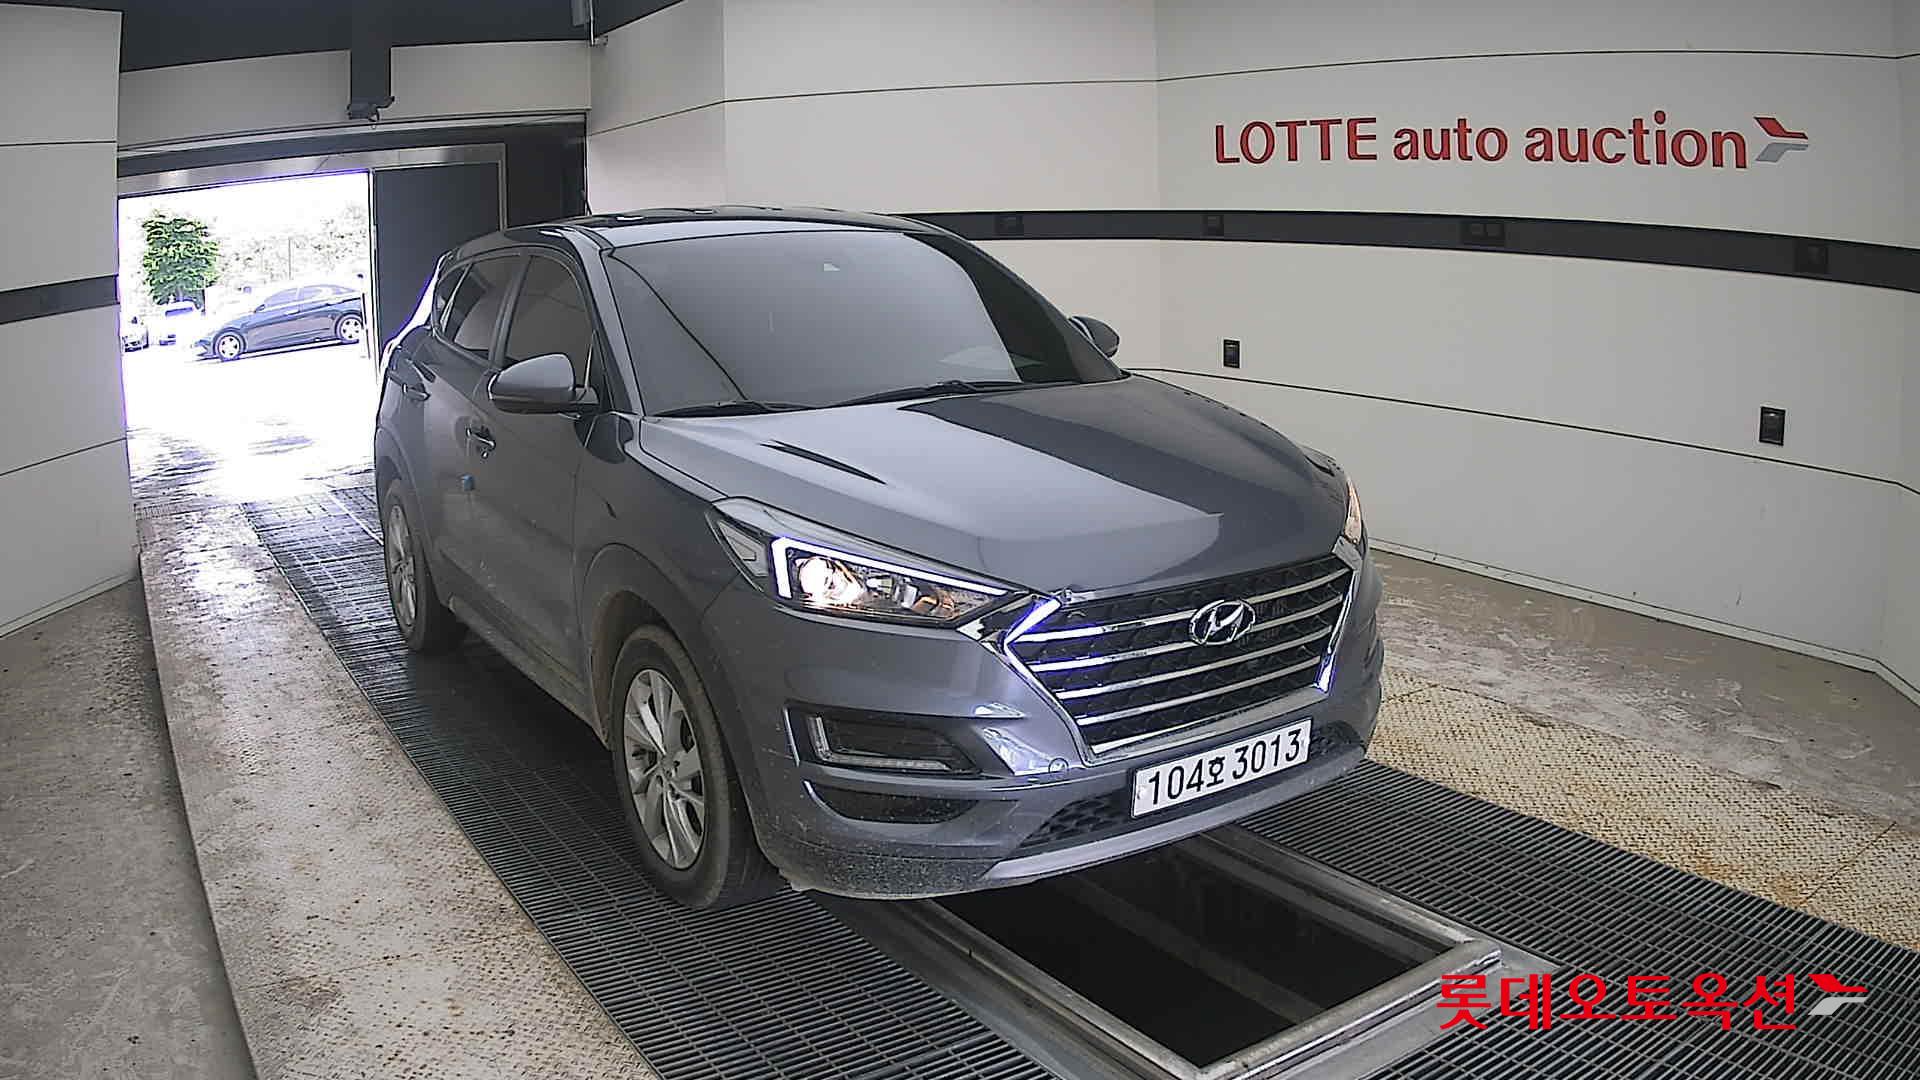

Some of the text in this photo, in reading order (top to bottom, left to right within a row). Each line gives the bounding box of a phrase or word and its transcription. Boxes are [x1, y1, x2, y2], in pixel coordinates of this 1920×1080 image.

[1215, 110, 1748, 169] LOTTE auto auction
[1148, 728, 1303, 805] 104호 3013
